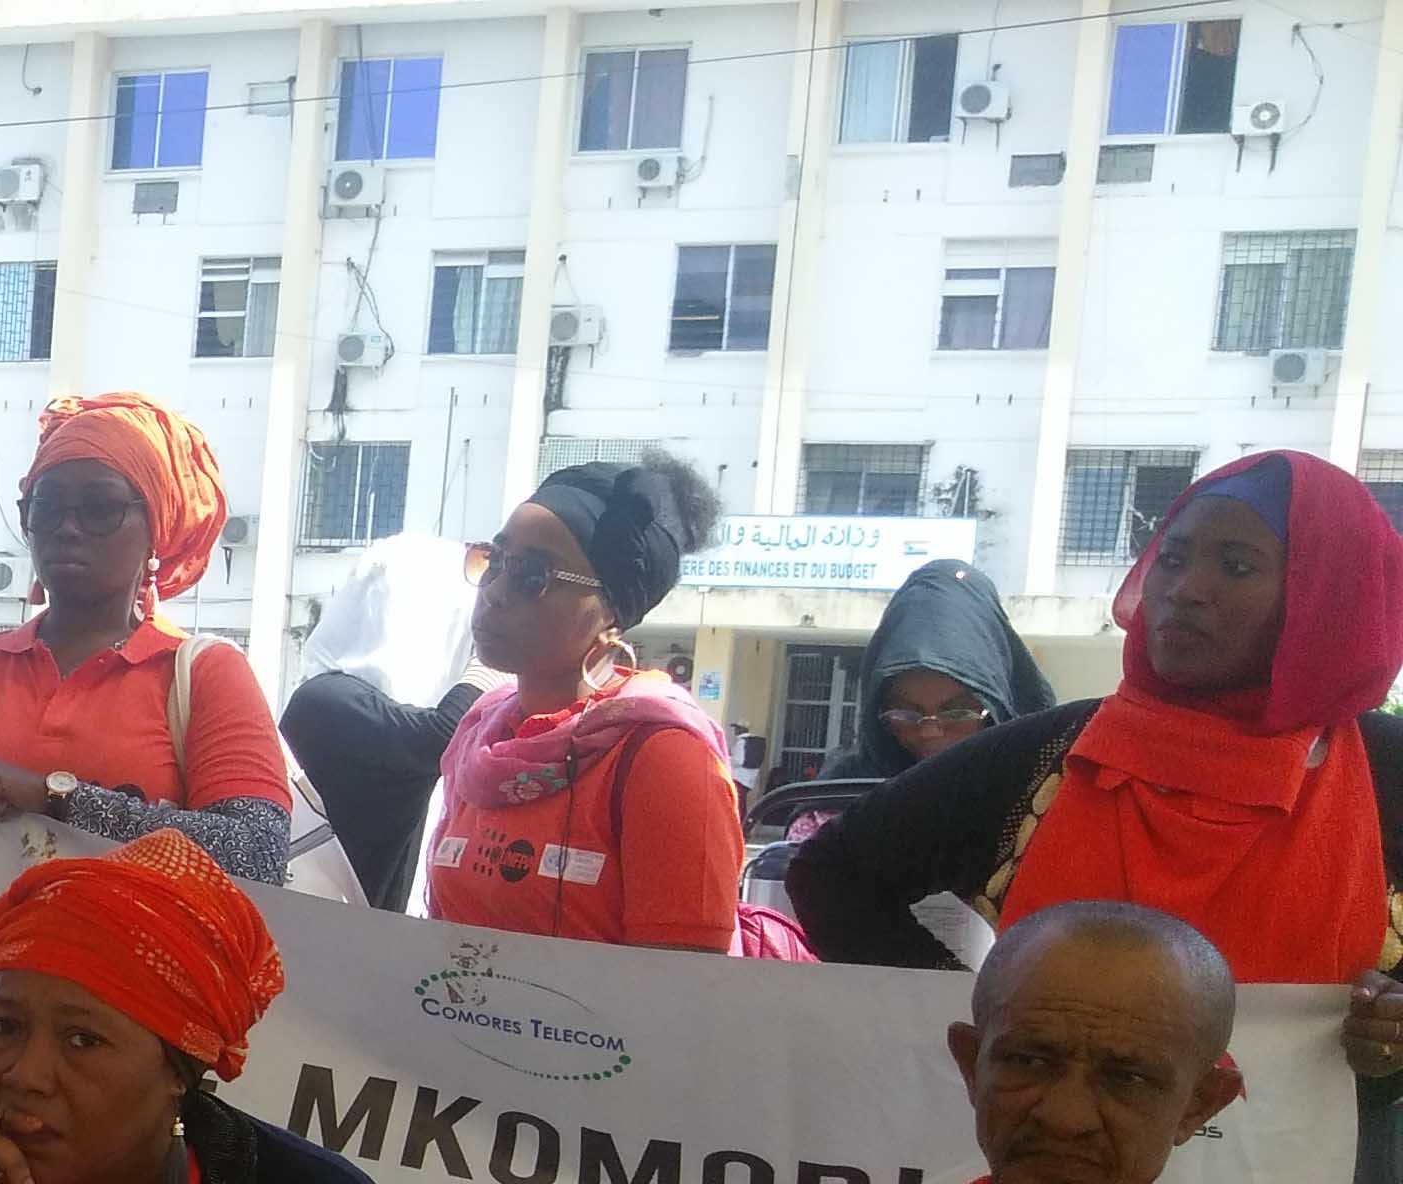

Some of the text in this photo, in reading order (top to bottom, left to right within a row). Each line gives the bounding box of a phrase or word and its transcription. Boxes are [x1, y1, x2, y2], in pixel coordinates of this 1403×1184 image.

[709, 561, 730, 576] DES
[734, 561, 789, 577] FINANCES
[794, 562, 808, 577] ET
[811, 563, 826, 577] DU
[830, 563, 878, 580] BUDGET
